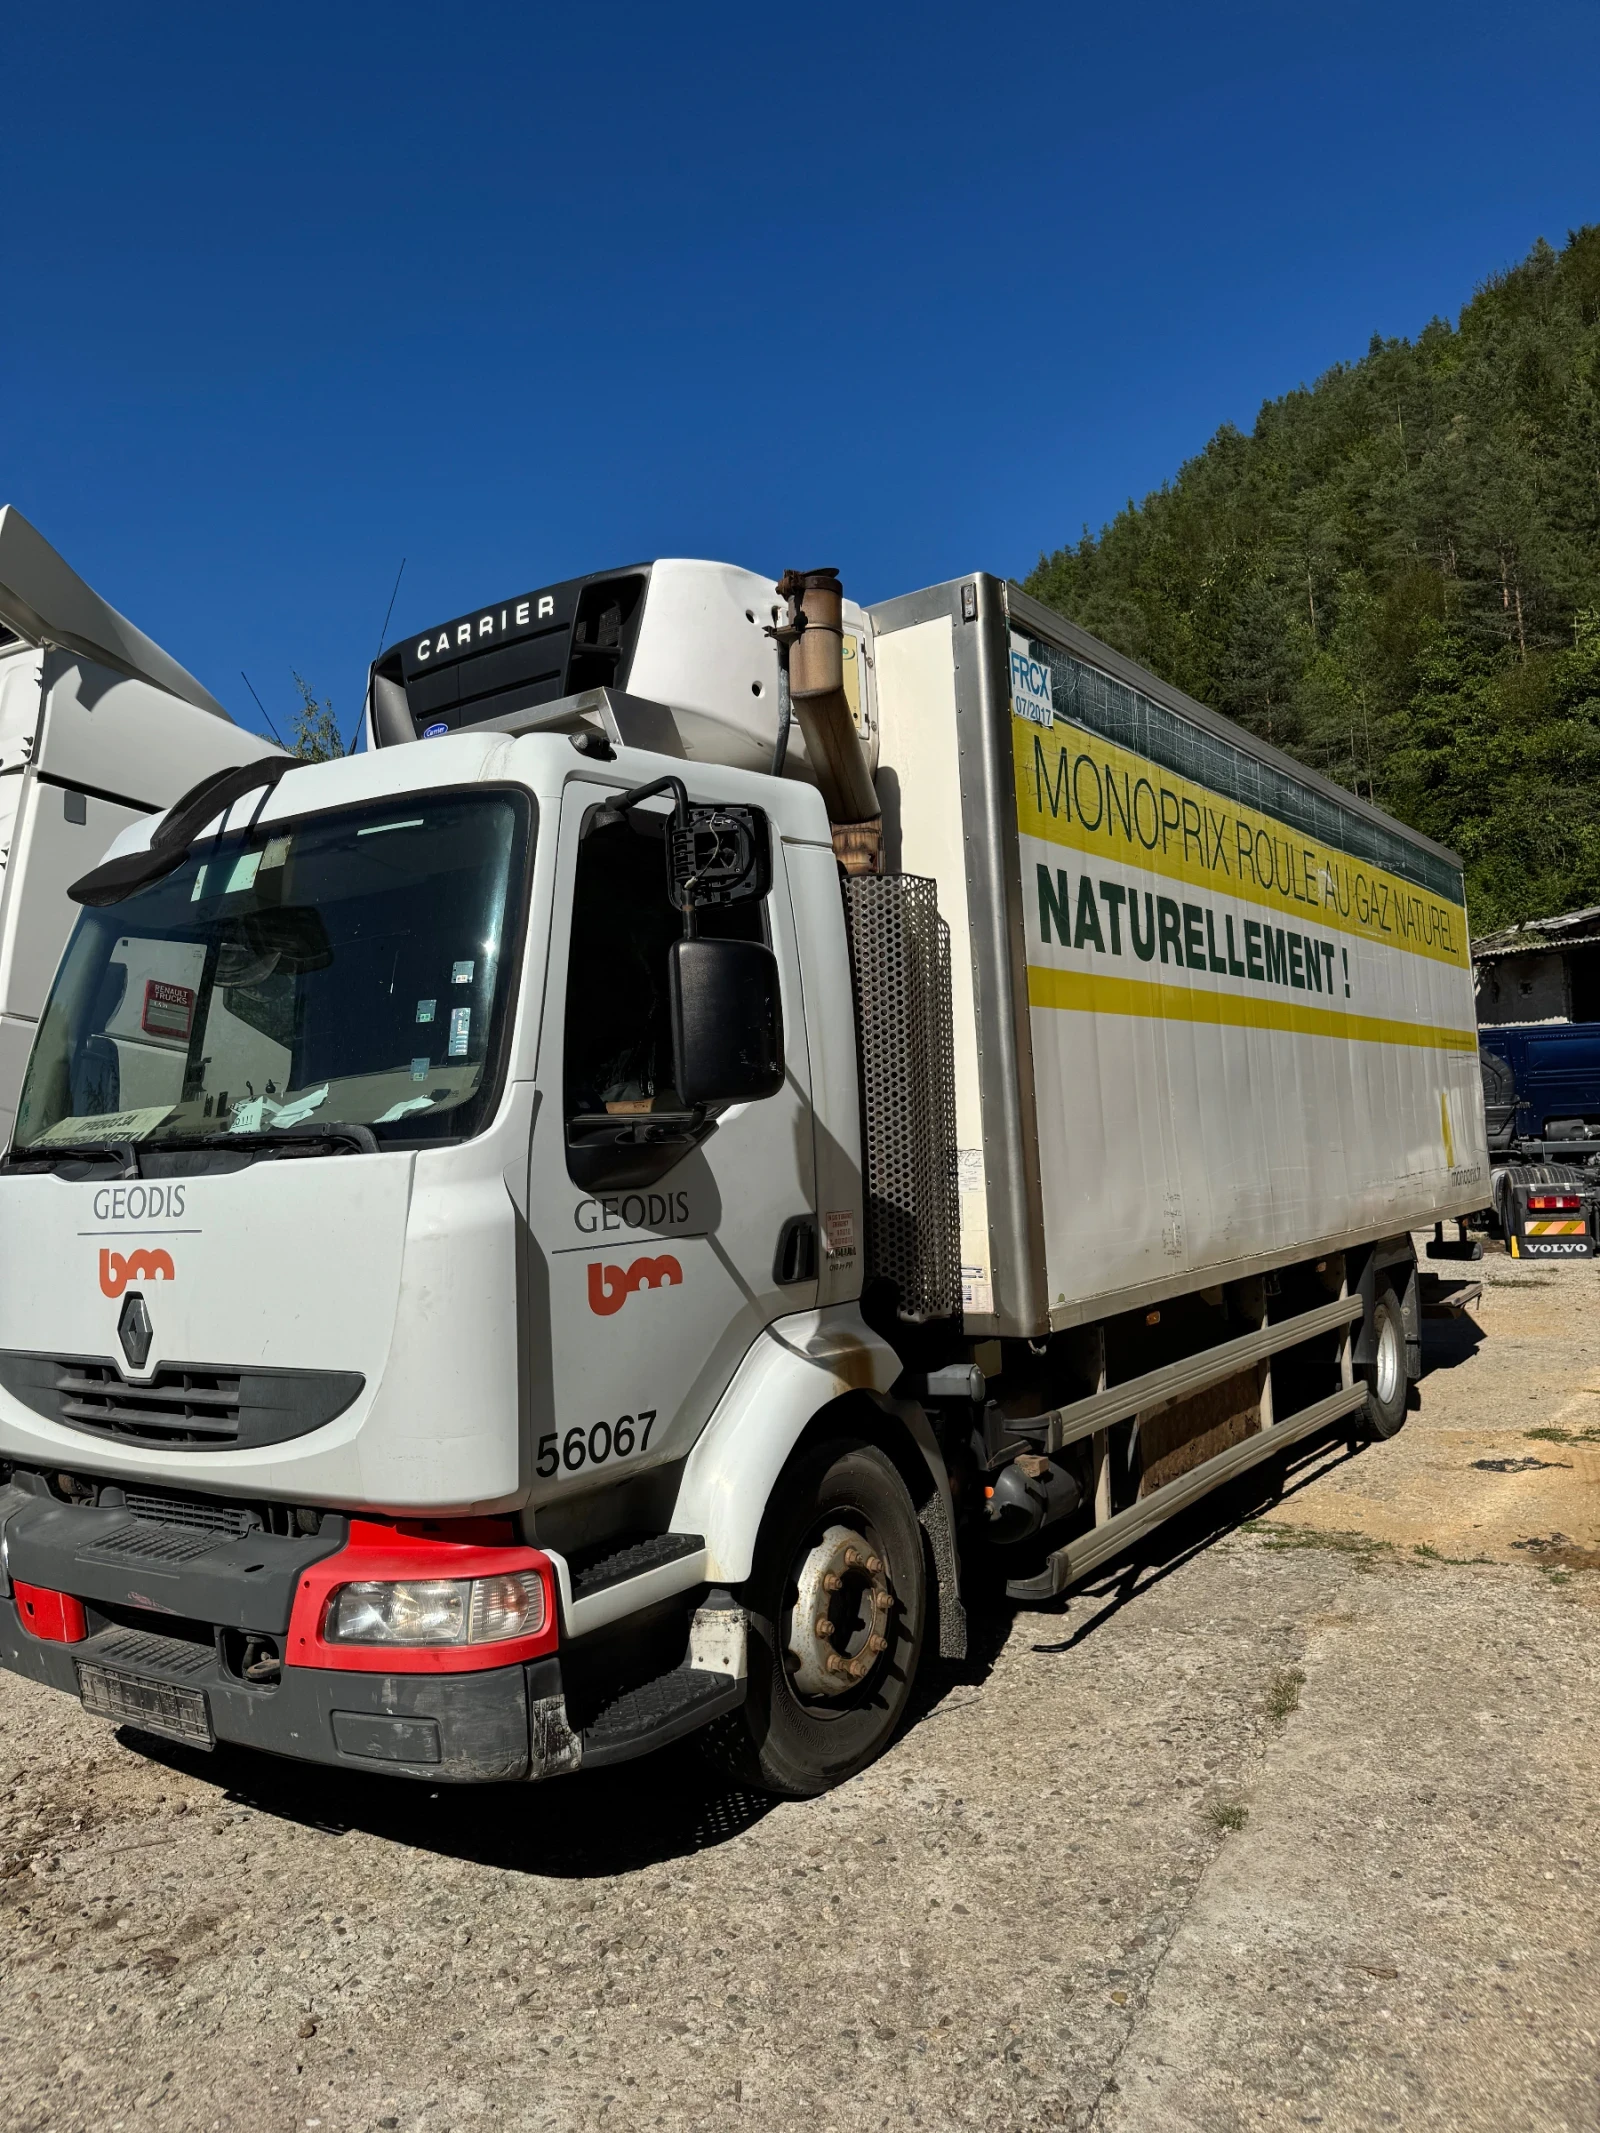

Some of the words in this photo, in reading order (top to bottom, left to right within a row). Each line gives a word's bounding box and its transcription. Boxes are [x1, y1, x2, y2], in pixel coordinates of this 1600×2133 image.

[417, 595, 554, 661] CARRIER
[1010, 651, 1050, 701] FRCX
[1015, 695, 1051, 725] 07/2017
[1034, 735, 1230, 876] MONOPRIX
[1236, 819, 1319, 907] ROULE
[1324, 860, 1350, 918] AU
[1355, 873, 1392, 932] GAZ
[1036, 863, 1334, 995] NATURELLEMENT
[1341, 947, 1351, 999] !
[154, 984, 188, 998] RENAULT
[154, 992, 188, 1005] TRUCKS
[93, 1184, 186, 1220] GEODIS
[573, 1191, 689, 1233] GEODIS
[1524, 1243, 1588, 1253] VOLVO
[99, 1248, 175, 1299] bm
[587, 1254, 683, 1316] bm
[535, 1409, 657, 1478] 56067
